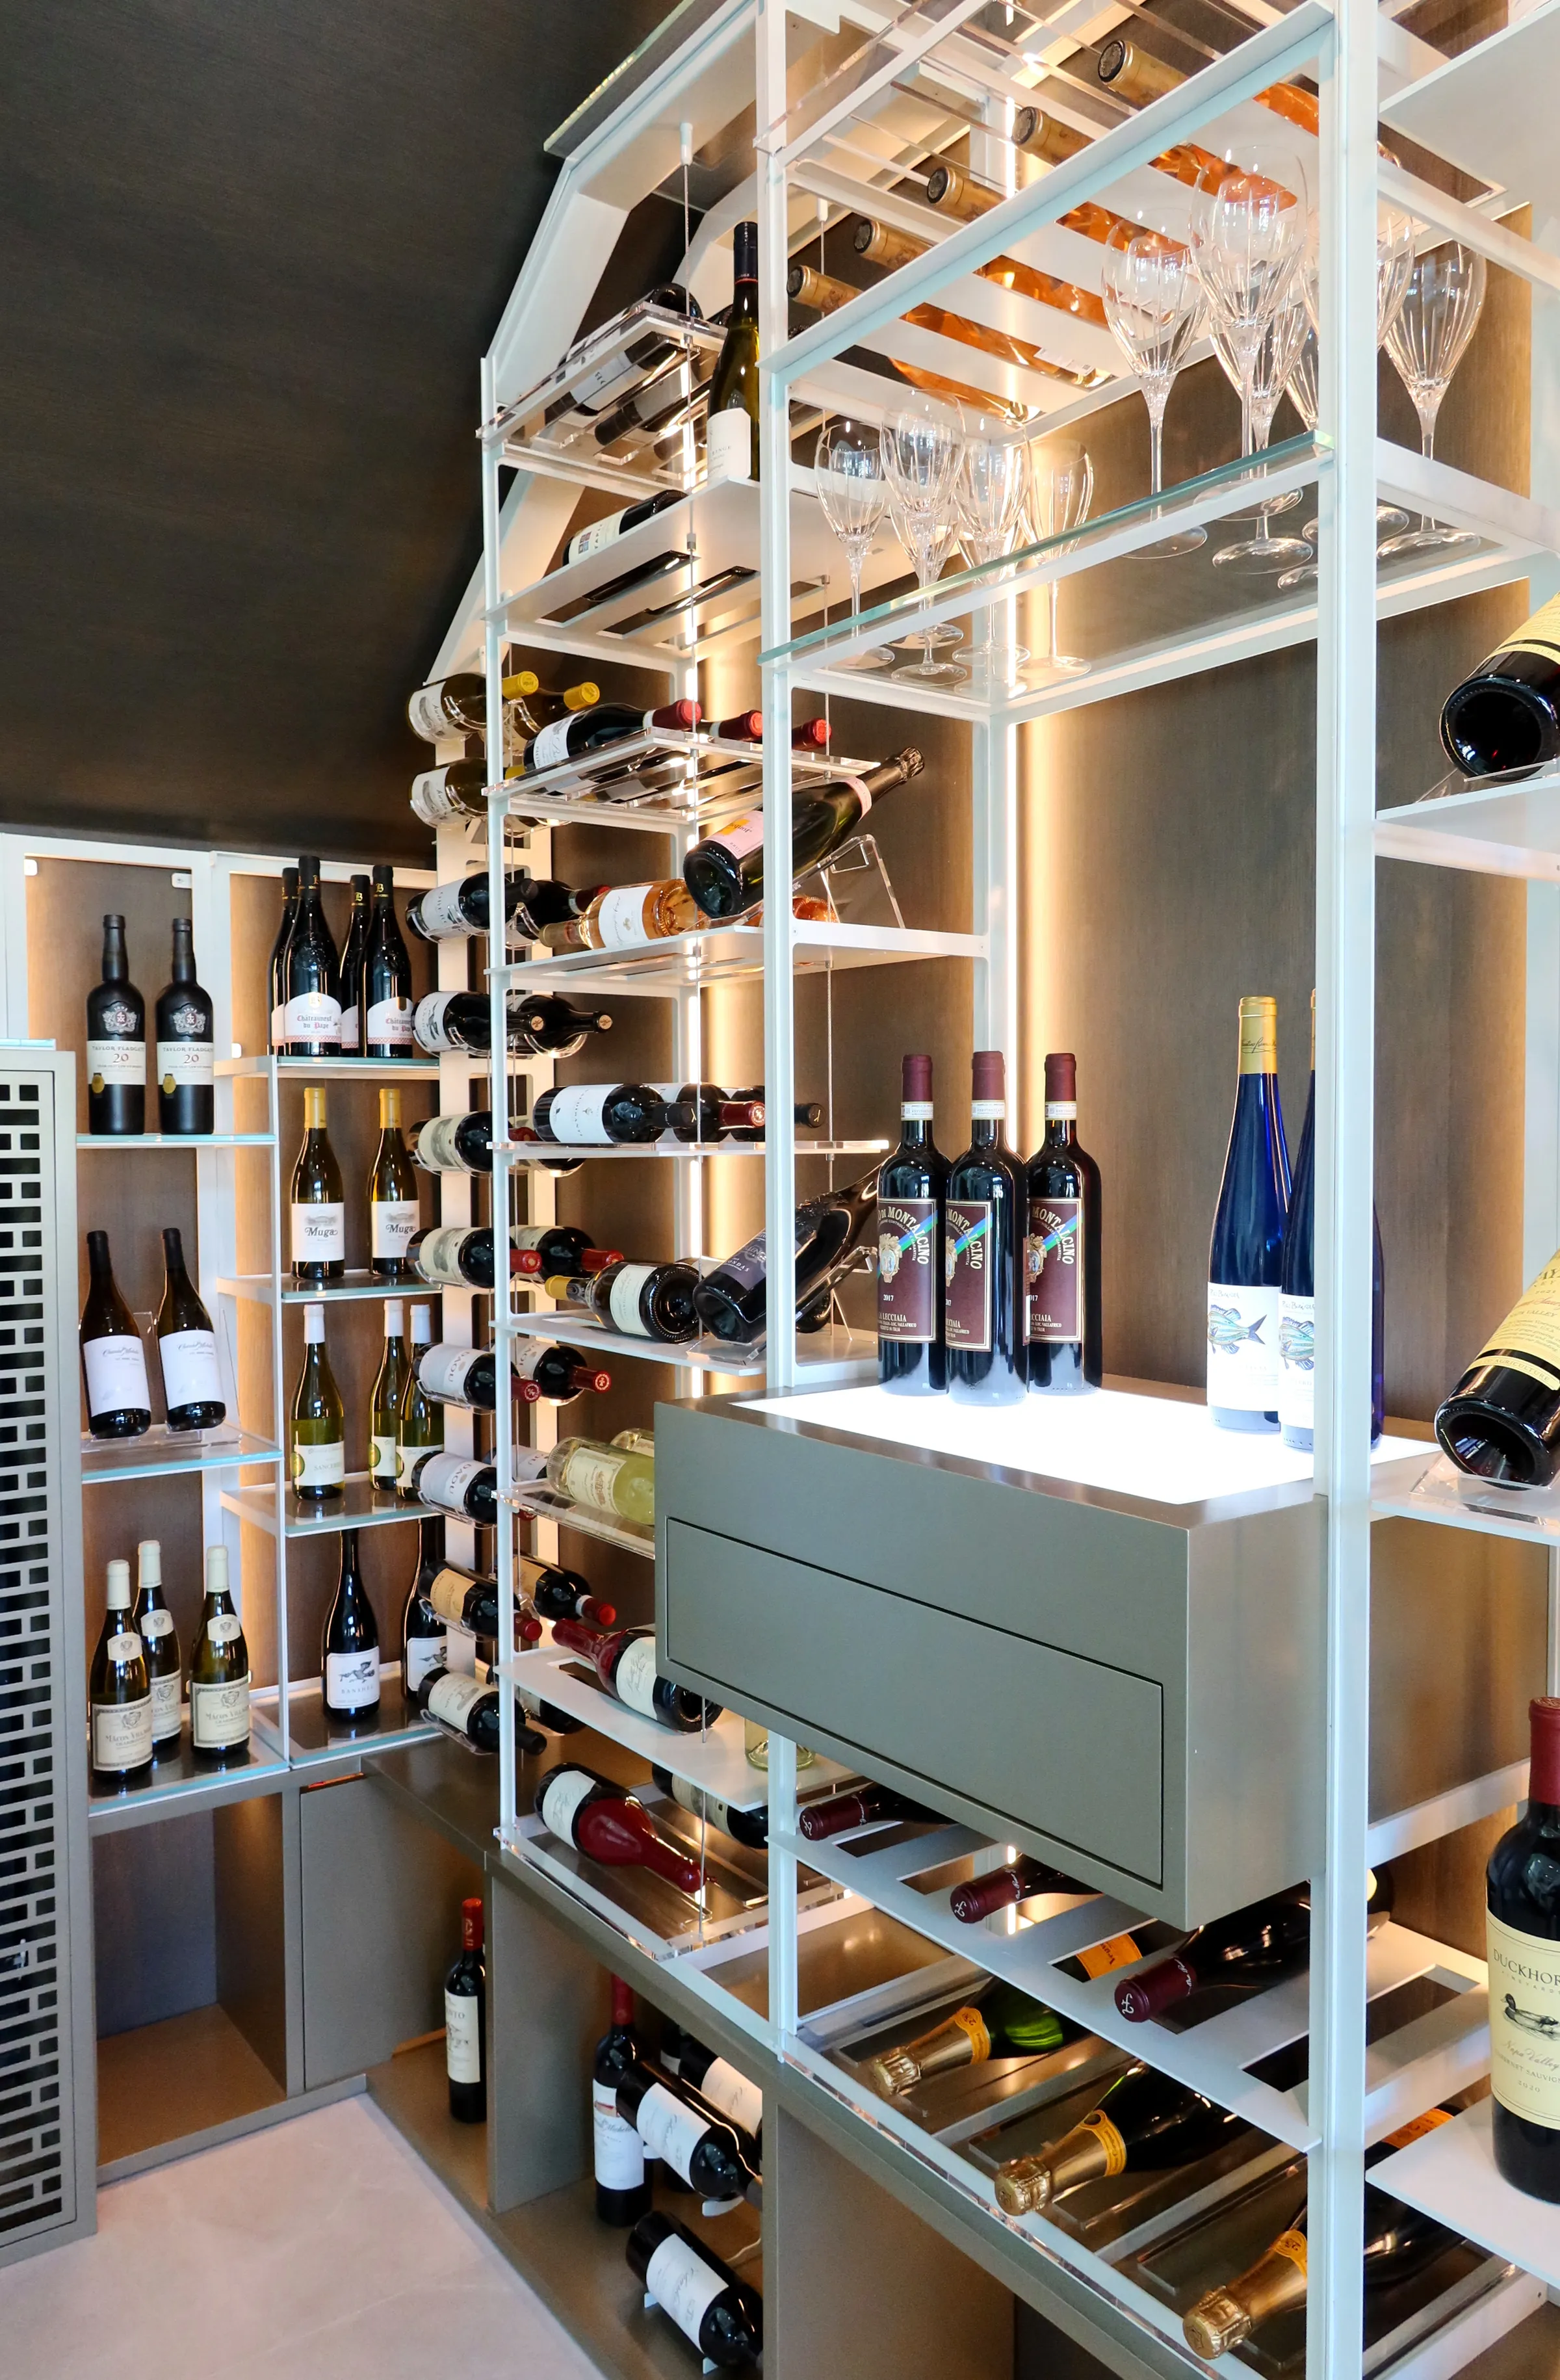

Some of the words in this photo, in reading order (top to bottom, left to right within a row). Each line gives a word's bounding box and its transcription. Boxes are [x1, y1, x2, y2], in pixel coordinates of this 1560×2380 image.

[112, 1053, 129, 1063] 20
[183, 1054, 200, 1064] 20
[304, 1226, 338, 1238] Muga
[385, 1223, 417, 1234] Muga
[881, 1209, 887, 1219] DI
[887, 1206, 930, 1264] MONTALCINO
[1032, 1206, 1075, 1264] MONTALCINO
[948, 1208, 983, 1270] MONTALCINO
[883, 1313, 907, 1322] LECCIAIA
[1031, 1313, 1052, 1322] CCIAIA
[1495, 1359, 1550, 1382] AGRICULTURE
[449, 1463, 472, 1495] DAOU
[341, 1685, 374, 1695] BANSHEE
[1493, 1948, 1560, 1986] DUCKHOR
[1502, 2040, 1524, 2058] Napa
[1524, 2048, 1560, 2071] Valley
[1526, 2069, 1560, 2084] SAUVIG
[1517, 2080, 1540, 2093] 2020
